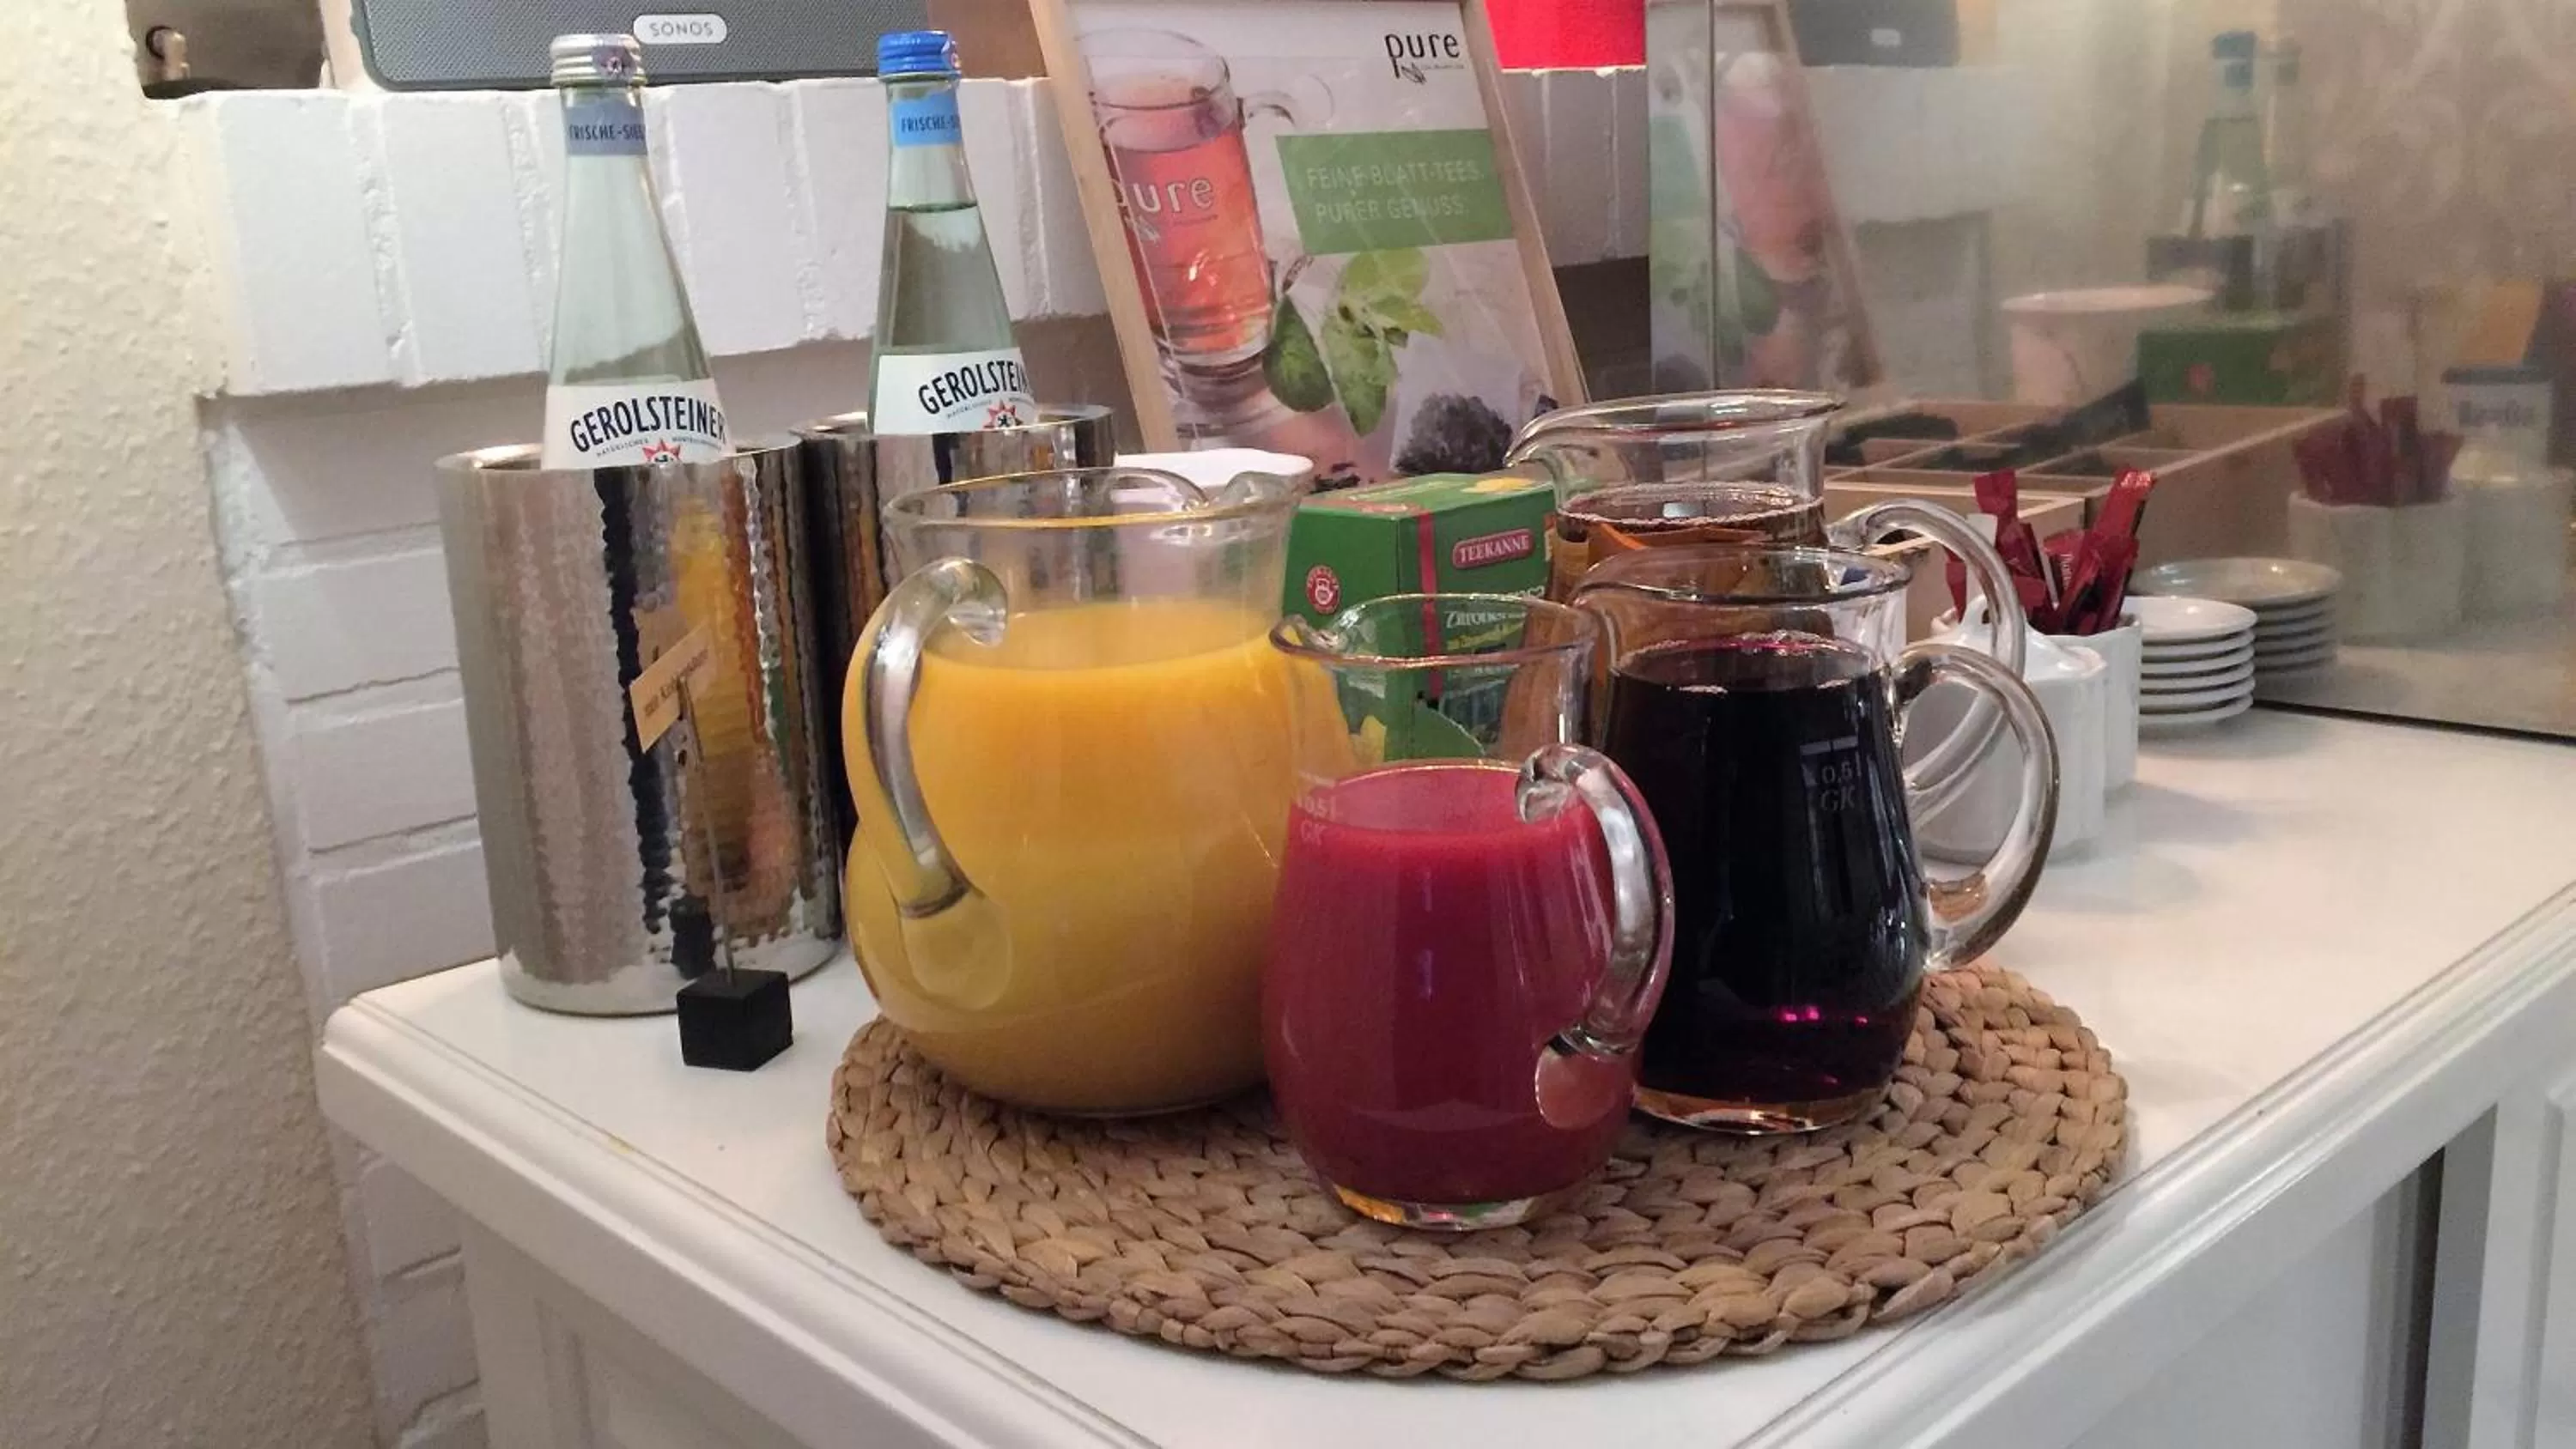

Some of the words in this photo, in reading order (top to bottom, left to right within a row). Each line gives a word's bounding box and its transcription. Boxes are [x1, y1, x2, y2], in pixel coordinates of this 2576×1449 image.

[648, 21, 714, 37] SONOS
[1385, 33, 1460, 79] pure
[1316, 199, 1381, 224] PURER
[570, 396, 727, 452] GEROLSTEINER
[1460, 534, 1530, 563] TEEKANNE
